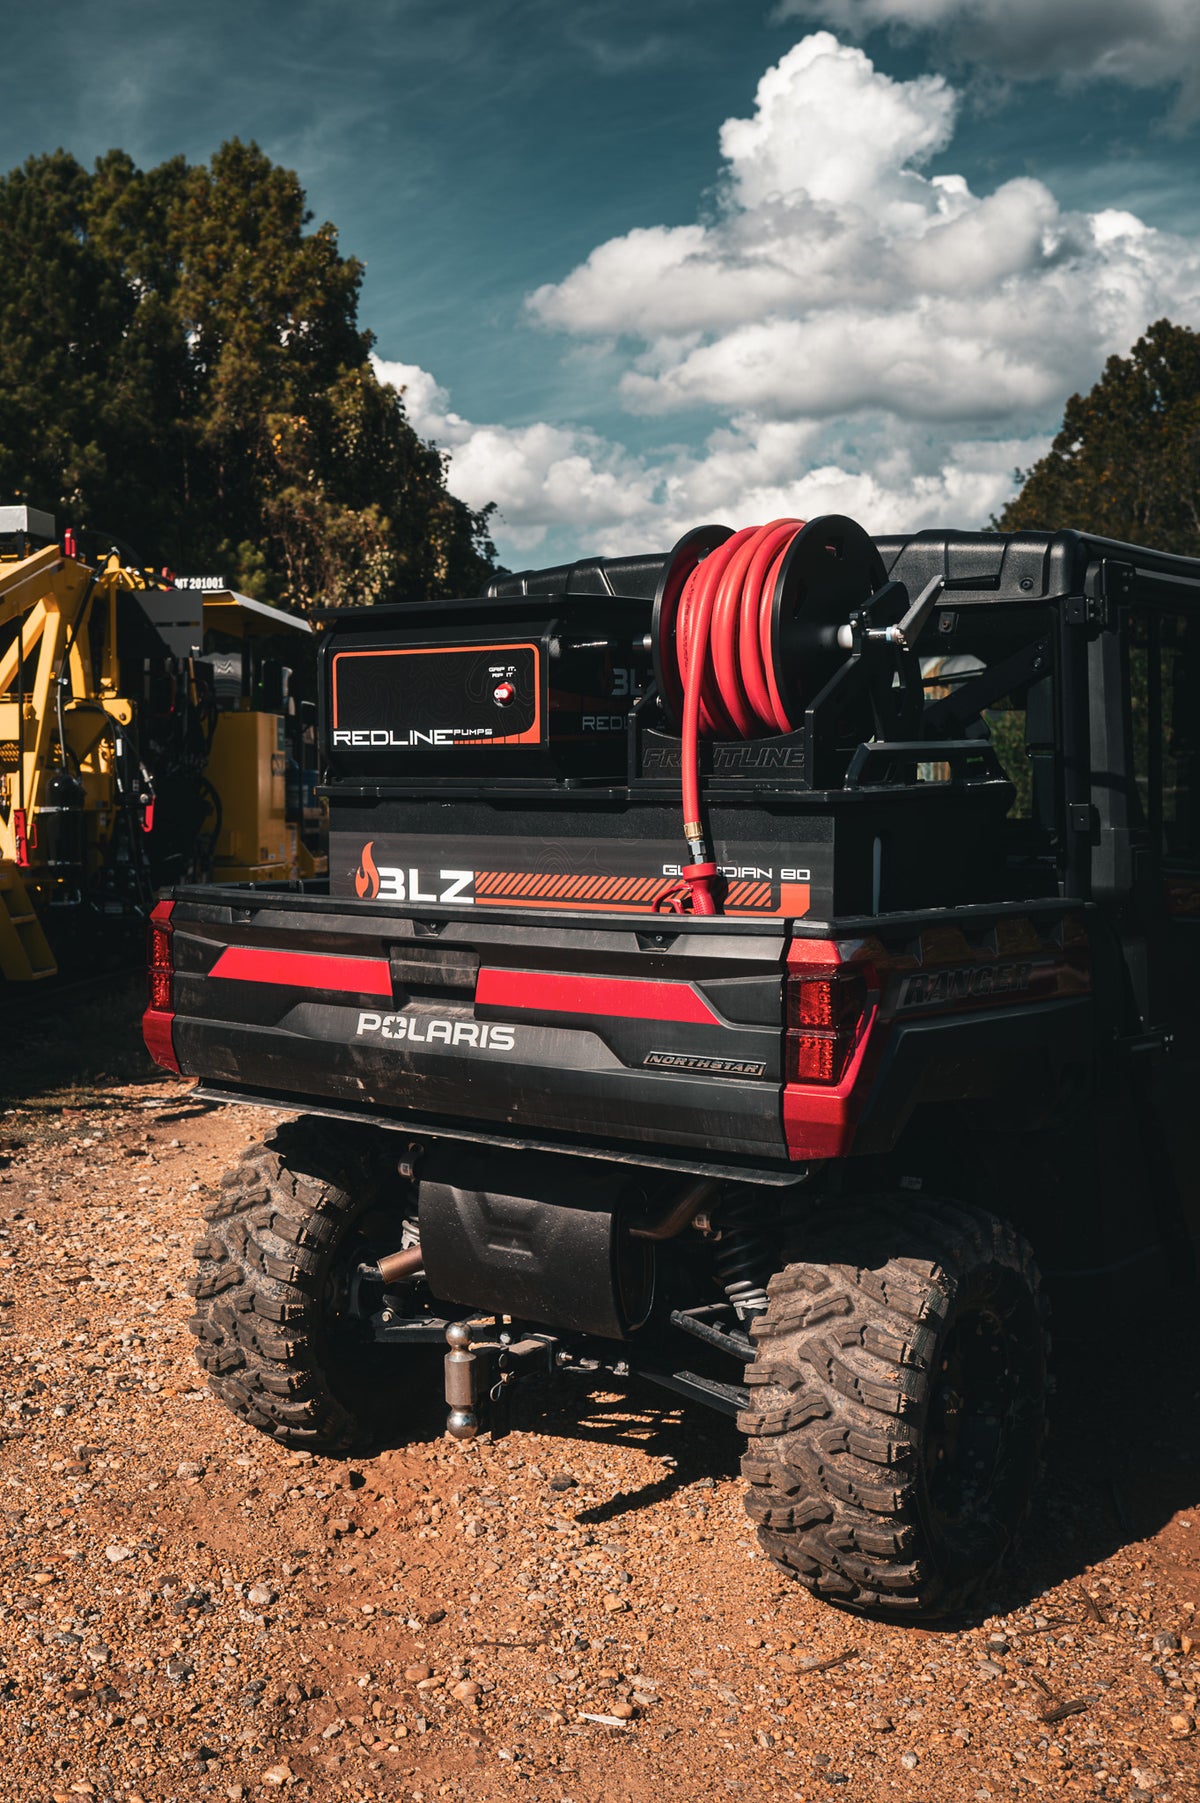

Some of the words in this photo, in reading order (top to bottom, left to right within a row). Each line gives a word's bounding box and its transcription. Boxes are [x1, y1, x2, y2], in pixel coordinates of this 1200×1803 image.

[333, 729, 453, 746] REDLINE
[371, 866, 475, 904] BLZ
[903, 962, 1033, 1006] RANGER
[356, 1012, 516, 1051] POLARIS
[649, 1054, 760, 1074] NORTHSTAR
